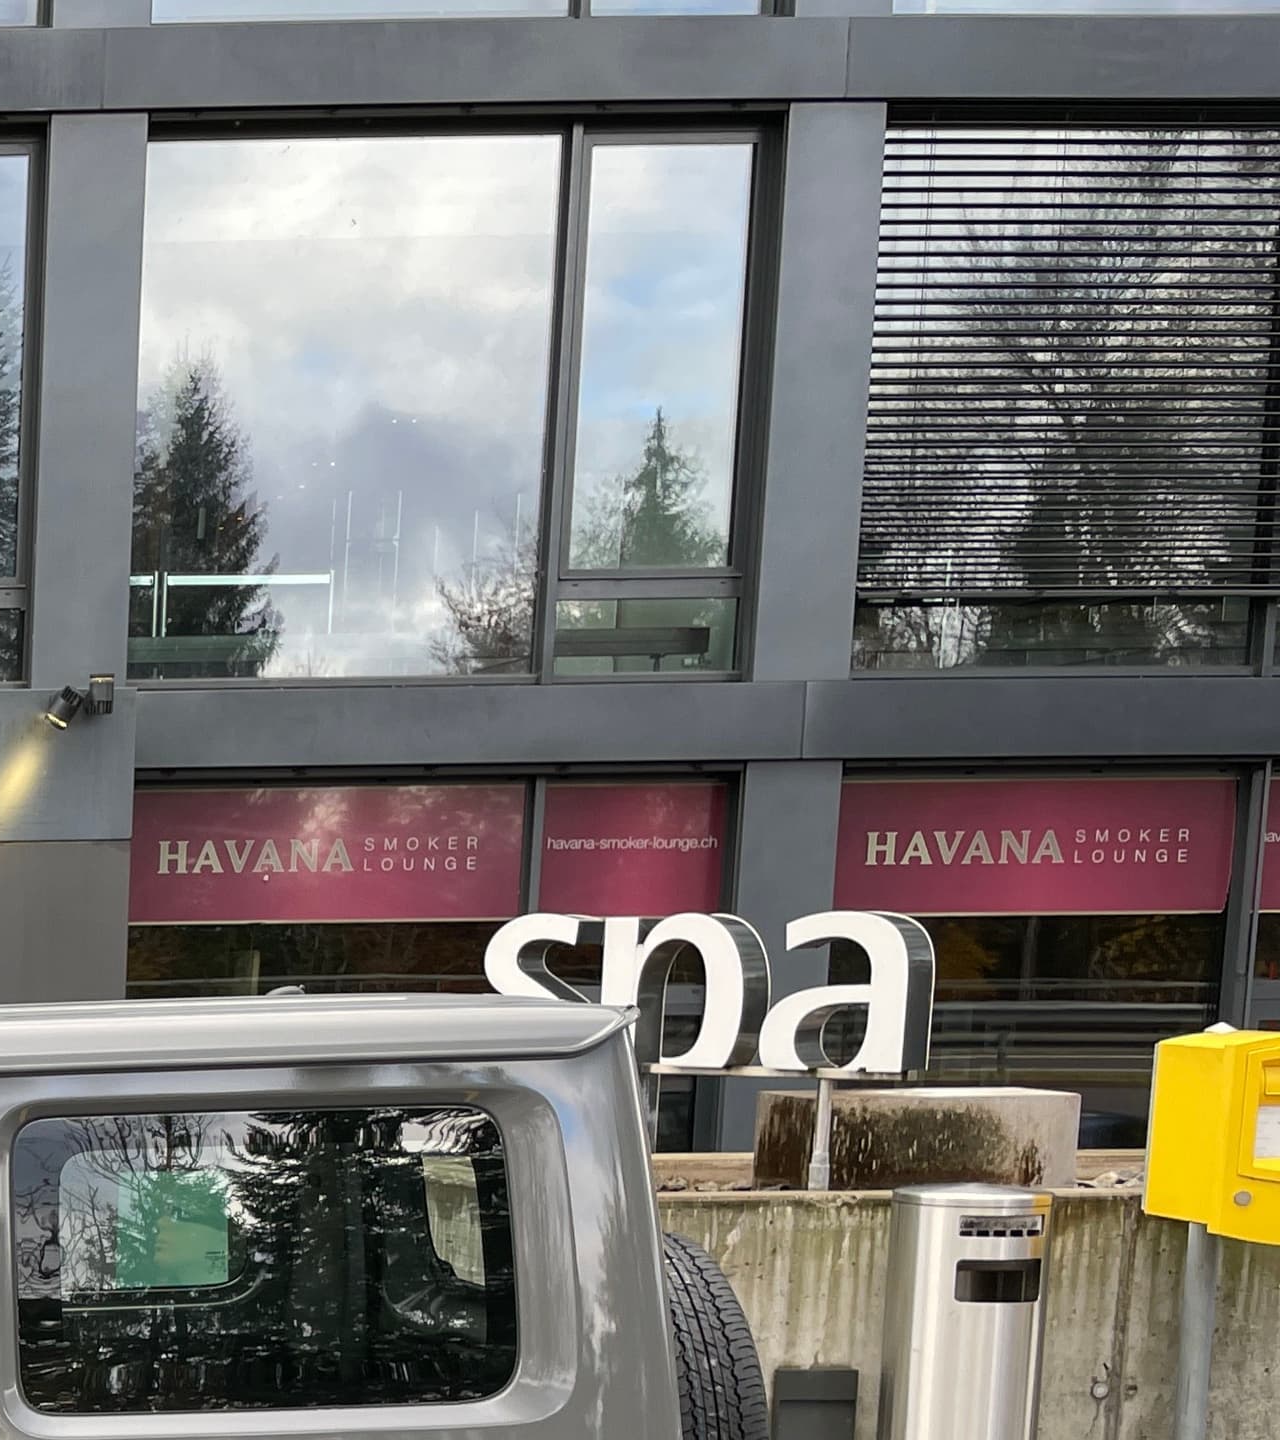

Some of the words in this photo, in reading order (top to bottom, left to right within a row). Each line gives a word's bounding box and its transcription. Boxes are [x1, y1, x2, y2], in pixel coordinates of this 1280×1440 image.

[364, 836, 478, 850] SMOKER
[1075, 828, 1190, 843] SMOKER
[547, 836, 718, 852] havana-smoker-lounge.ch
[864, 830, 1064, 865] HAVANA
[157, 838, 353, 874] HAVANA
[364, 856, 477, 871] LOUNGE
[1074, 849, 1188, 863] LOUNGE
